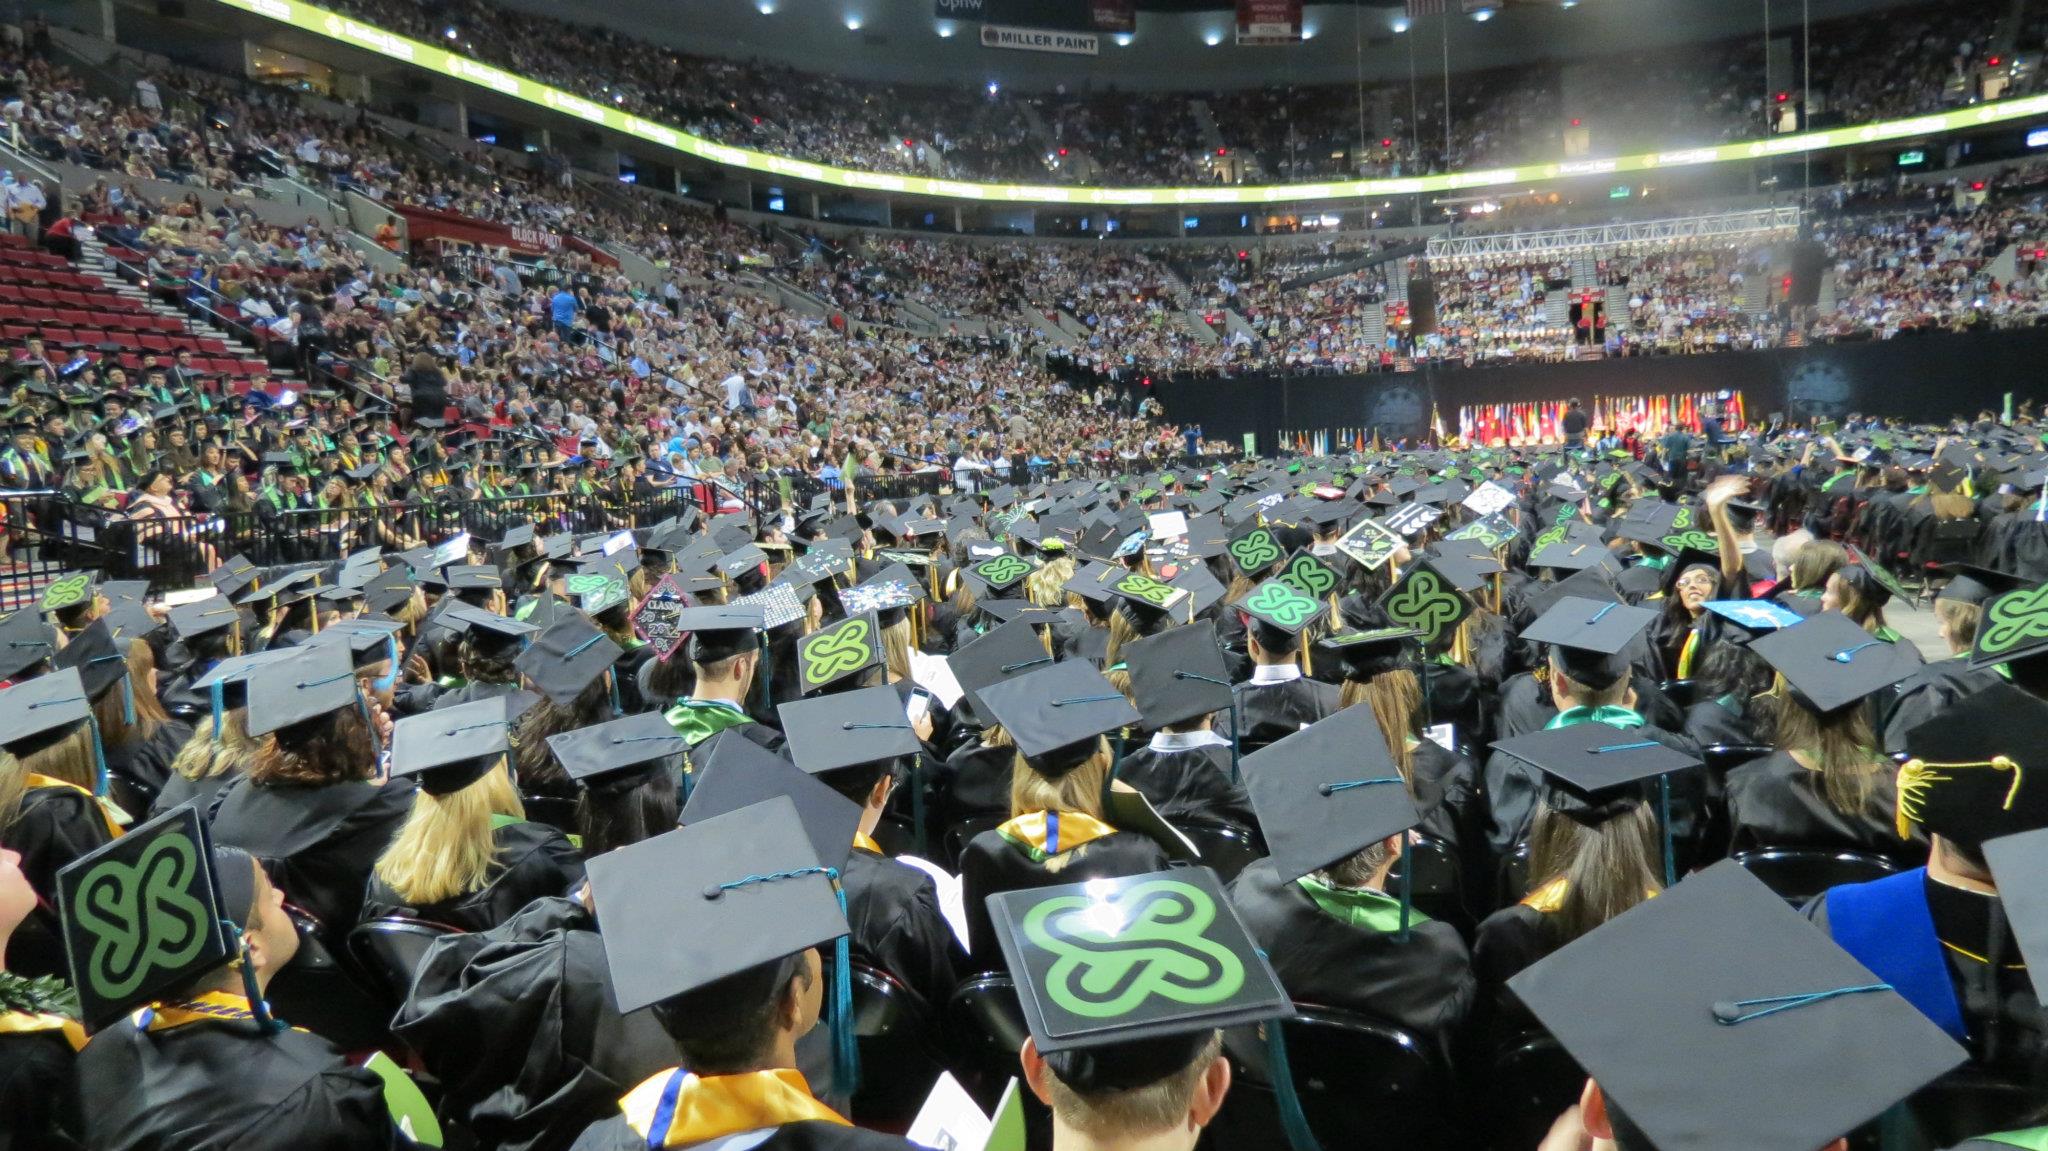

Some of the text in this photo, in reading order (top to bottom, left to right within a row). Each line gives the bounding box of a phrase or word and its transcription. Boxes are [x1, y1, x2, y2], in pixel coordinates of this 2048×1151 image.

[1001, 31, 1096, 50] MILLER PAINT
[512, 226, 538, 244] BLOCK
[648, 600, 674, 610] CLASS
